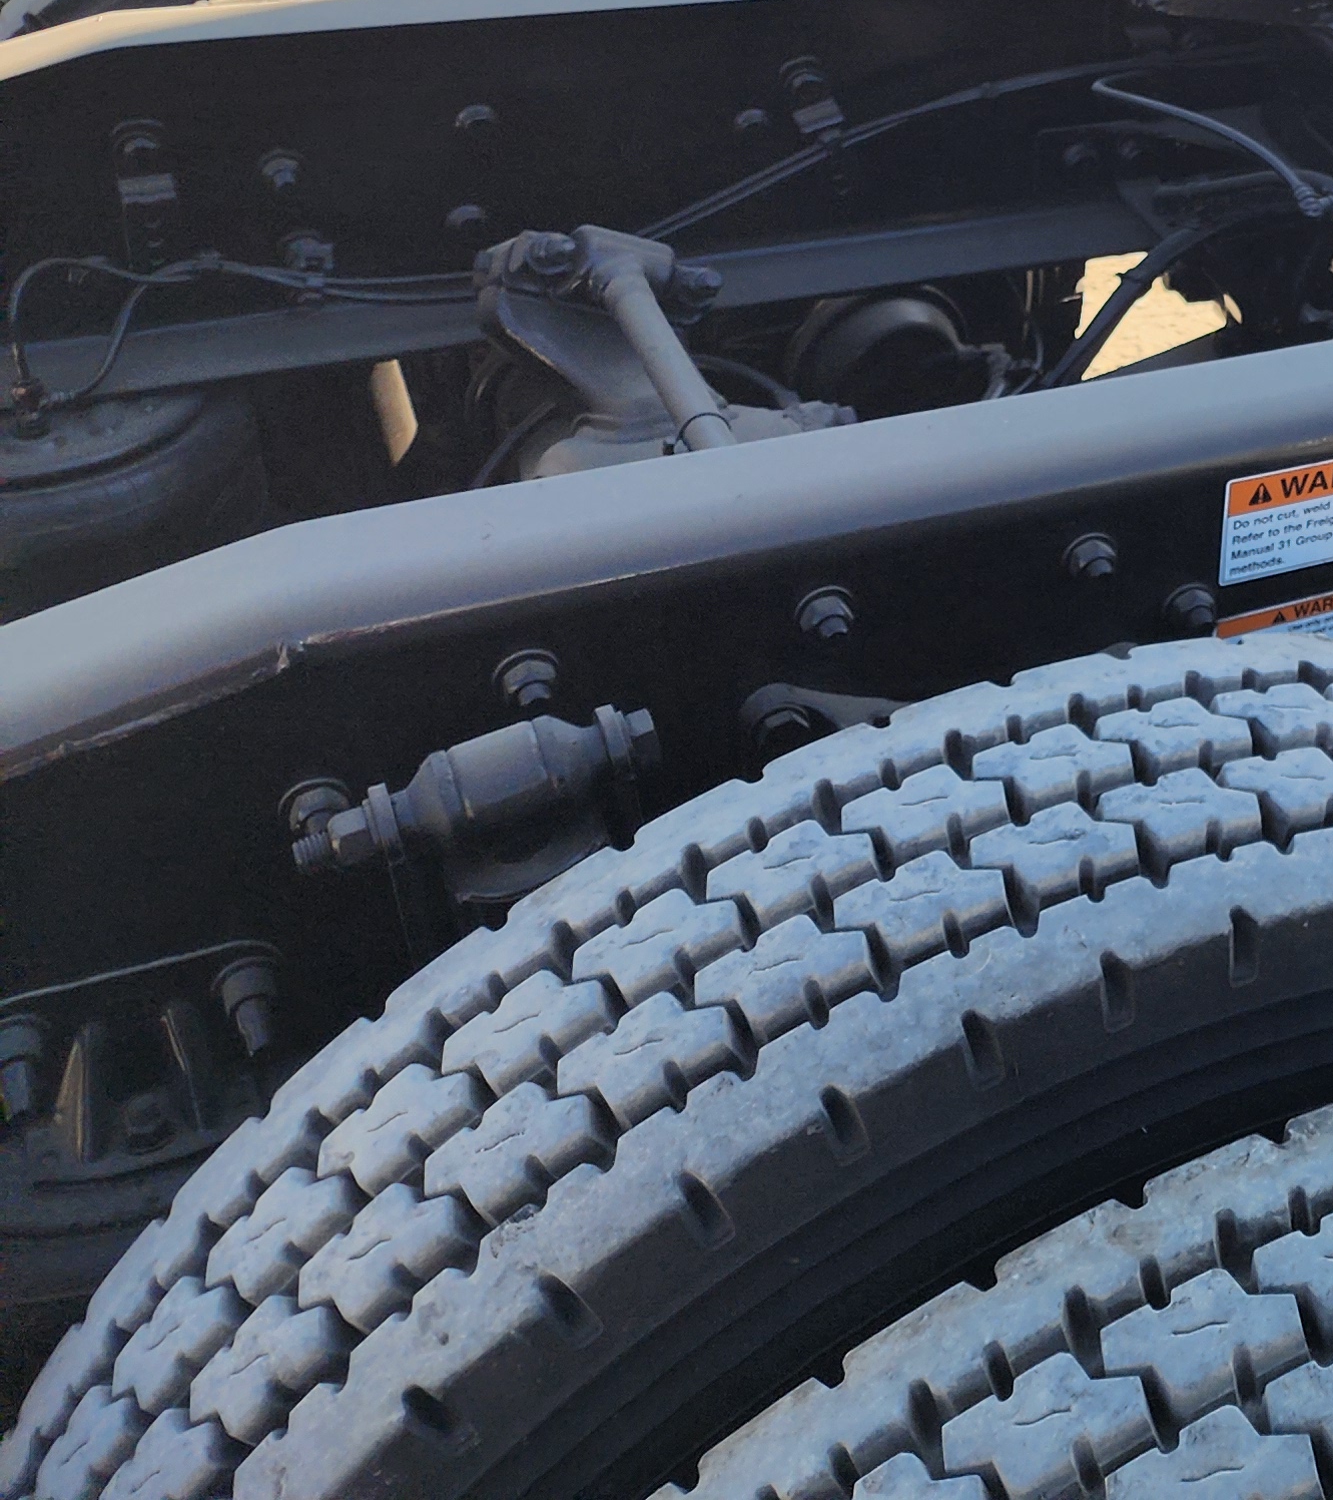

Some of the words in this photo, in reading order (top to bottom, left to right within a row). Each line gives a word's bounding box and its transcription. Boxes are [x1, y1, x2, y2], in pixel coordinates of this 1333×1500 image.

[1233, 518, 1250, 531] Do
[1254, 513, 1274, 527] not
[1277, 507, 1299, 521] cut,
[1303, 501, 1330, 515] weld
[1231, 543, 1275, 561] Manual
[1277, 539, 1291, 551] 31
[1296, 530, 1333, 547] Group
[1232, 531, 1264, 546] Refer
[1267, 527, 1280, 538] to
[1284, 522, 1302, 535] the
[1229, 557, 1286, 576] methods.
